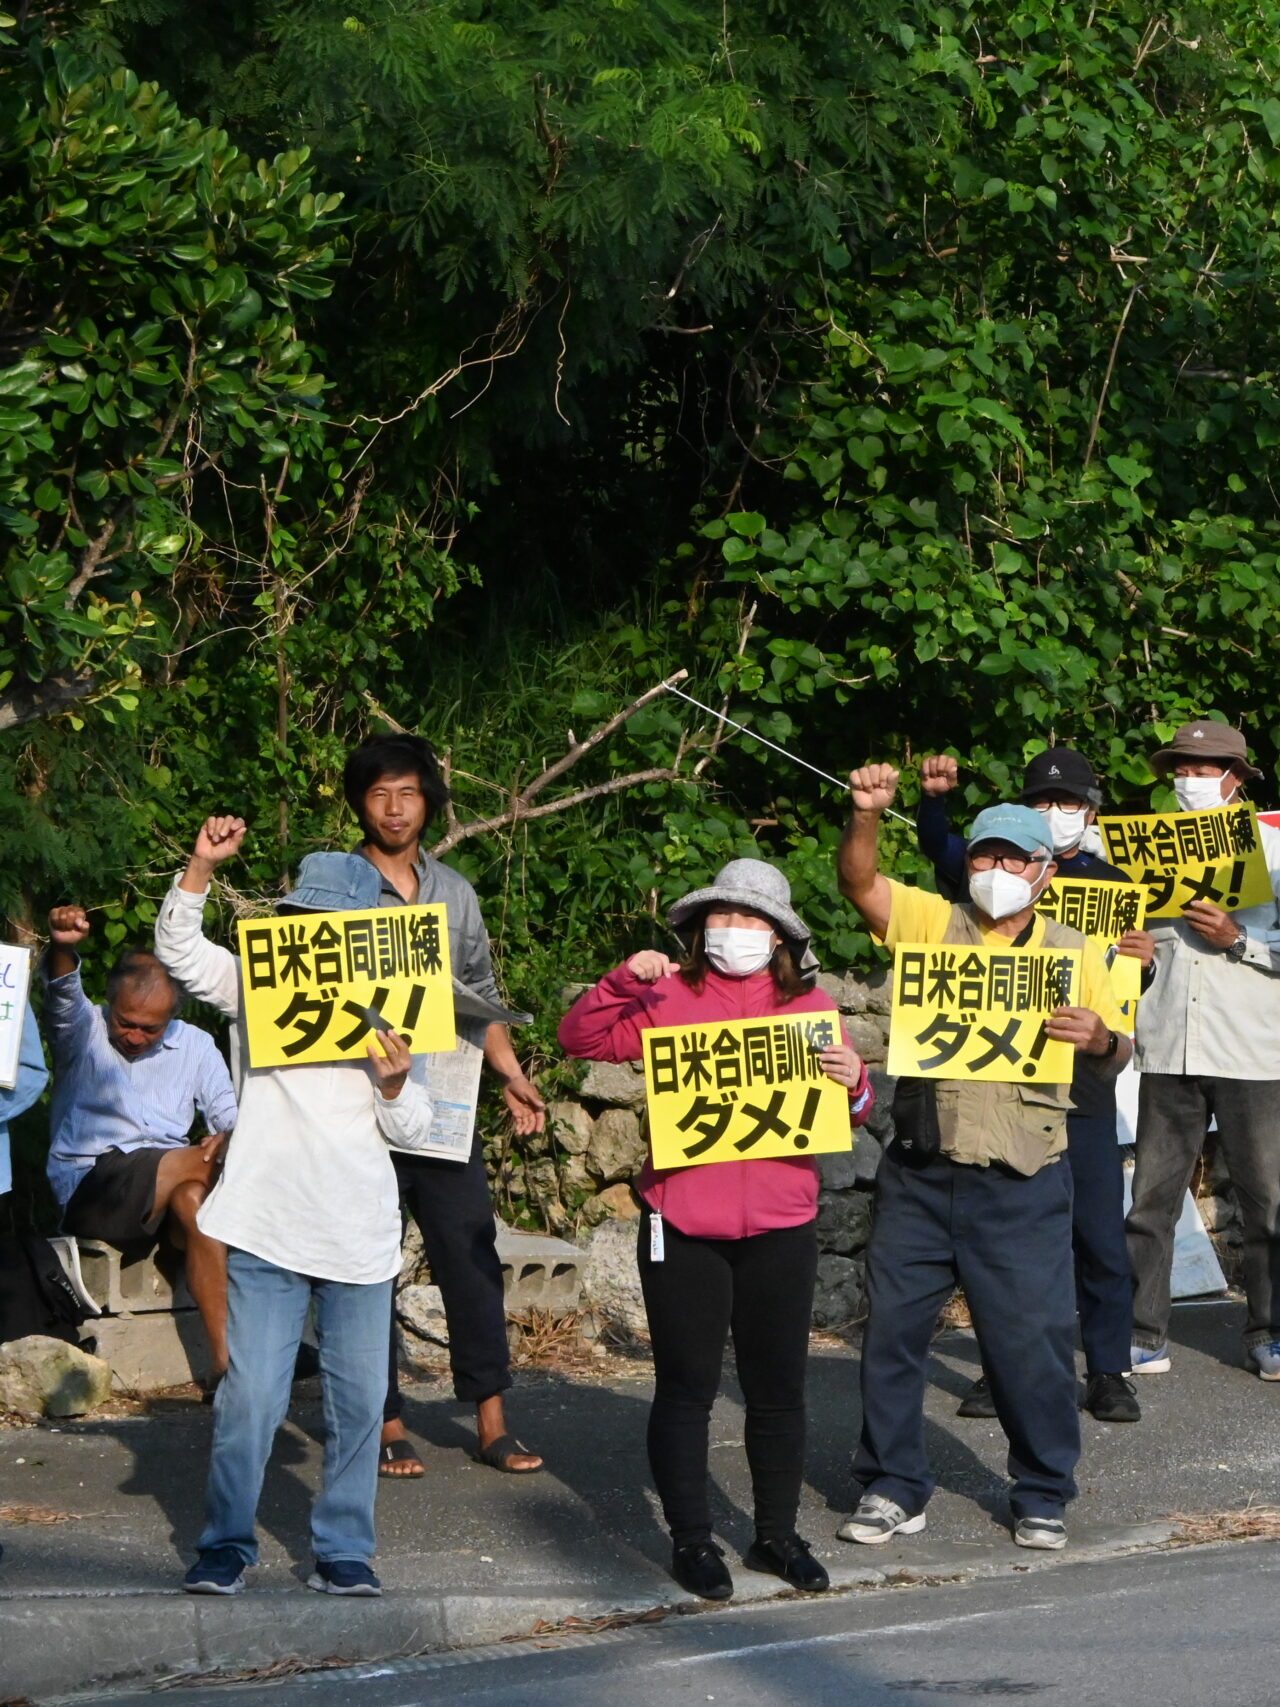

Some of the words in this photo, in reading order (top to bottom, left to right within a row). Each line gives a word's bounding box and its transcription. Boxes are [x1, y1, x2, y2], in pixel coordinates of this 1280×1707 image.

[1104, 808, 1257, 866] 日米合同訓練
[1146, 860, 1246, 914] ダメ!
[246, 911, 443, 990] 日米合同訓練
[898, 952, 1073, 1013] 日米合同訓練
[273, 985, 426, 1057] ダメ!
[915, 1012, 1049, 1077] ダメ!
[649, 1018, 835, 1095] 日米合同訓練
[676, 1087, 823, 1159] ダメ!
